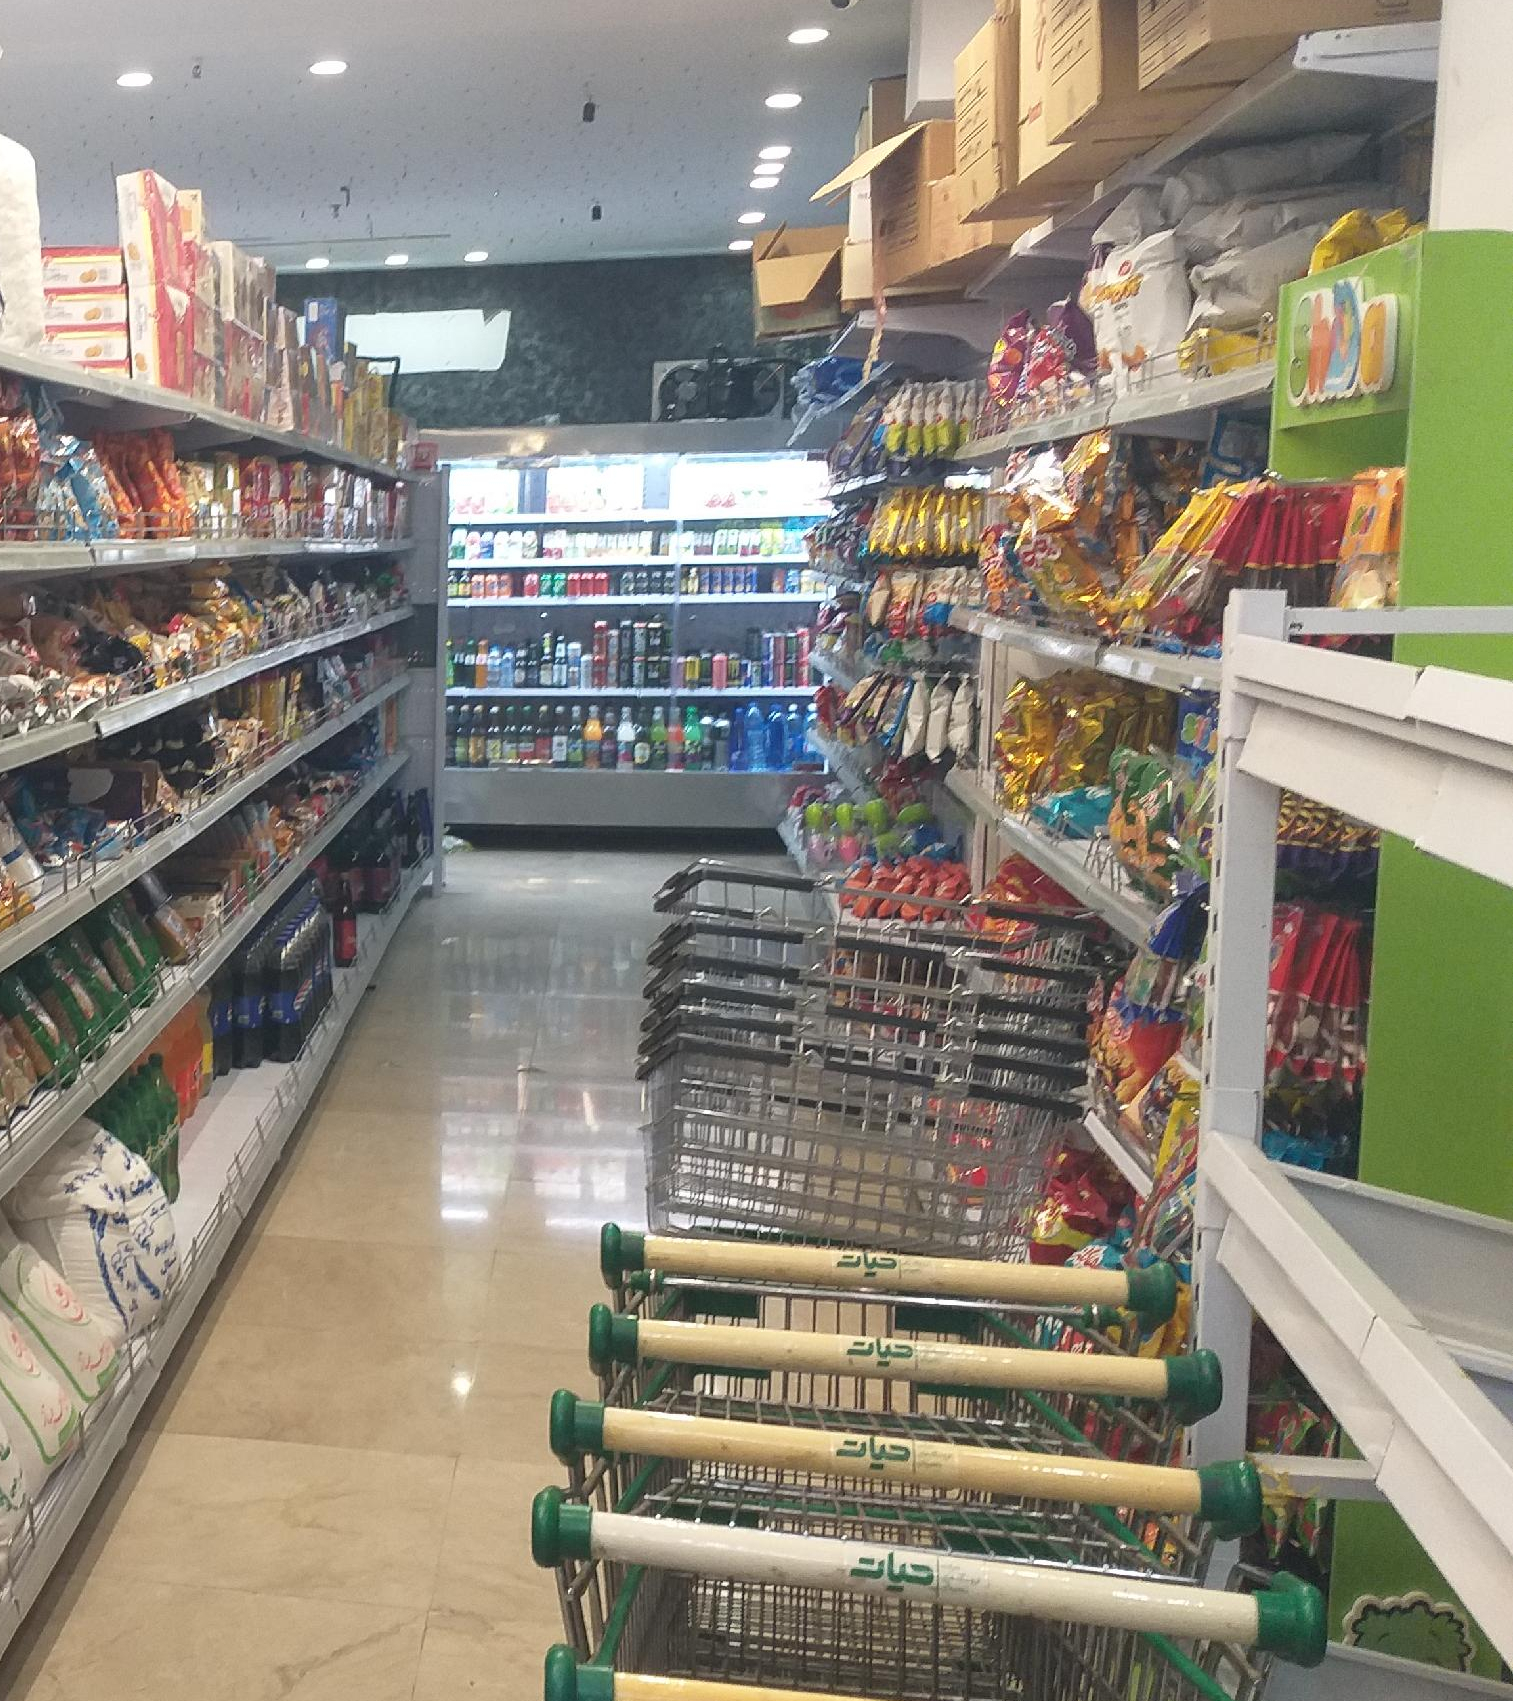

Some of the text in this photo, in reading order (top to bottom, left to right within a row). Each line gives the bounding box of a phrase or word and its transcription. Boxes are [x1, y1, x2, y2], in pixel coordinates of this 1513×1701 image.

[837, 1251, 897, 1278] حیات
[846, 1338, 913, 1367] حیات
[836, 1435, 911, 1470] حیات
[850, 1551, 935, 1593] حیات
